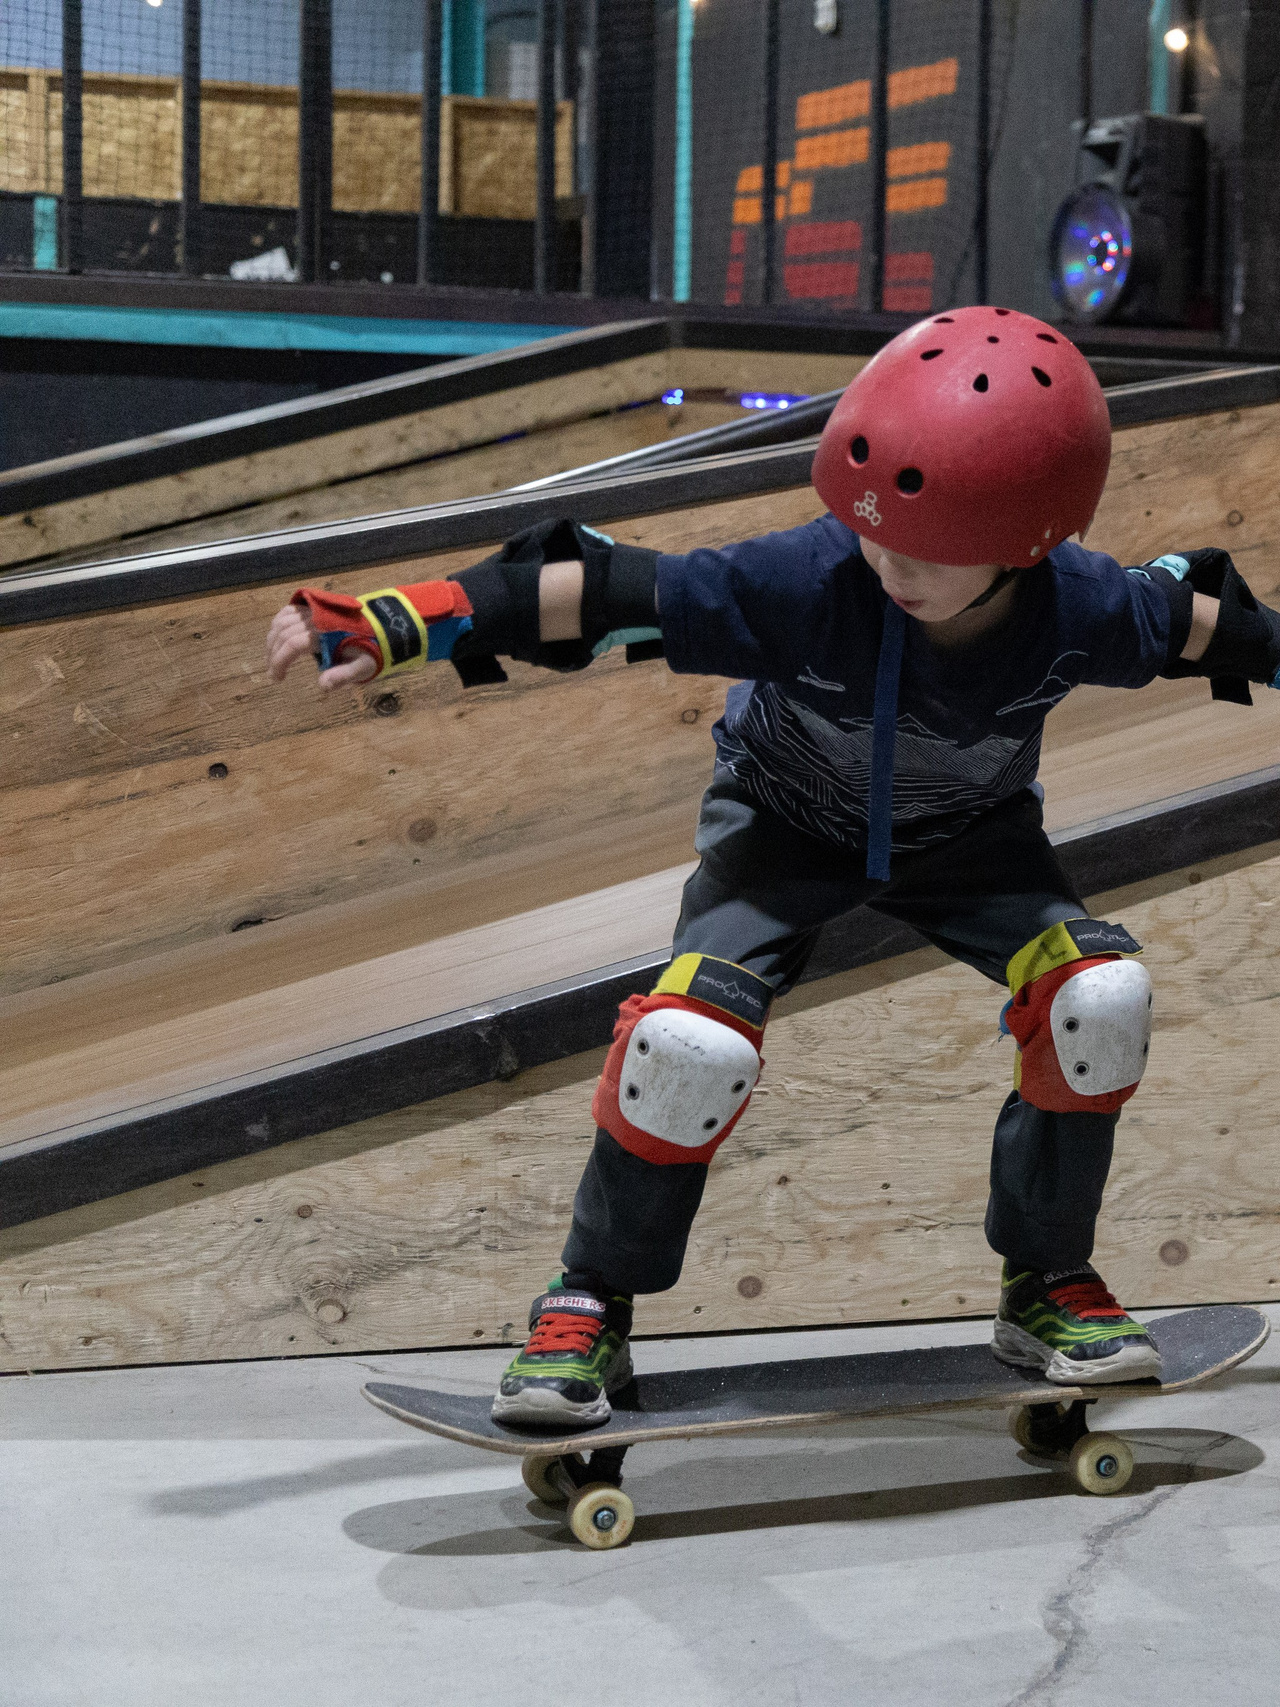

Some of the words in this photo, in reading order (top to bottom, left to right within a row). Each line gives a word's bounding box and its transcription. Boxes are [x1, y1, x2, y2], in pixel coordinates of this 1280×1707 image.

[1077, 933, 1101, 941] PRO
[698, 975, 724, 989] PRO
[740, 991, 763, 1008] TEC
[541, 1296, 606, 1312] SKECHERS
